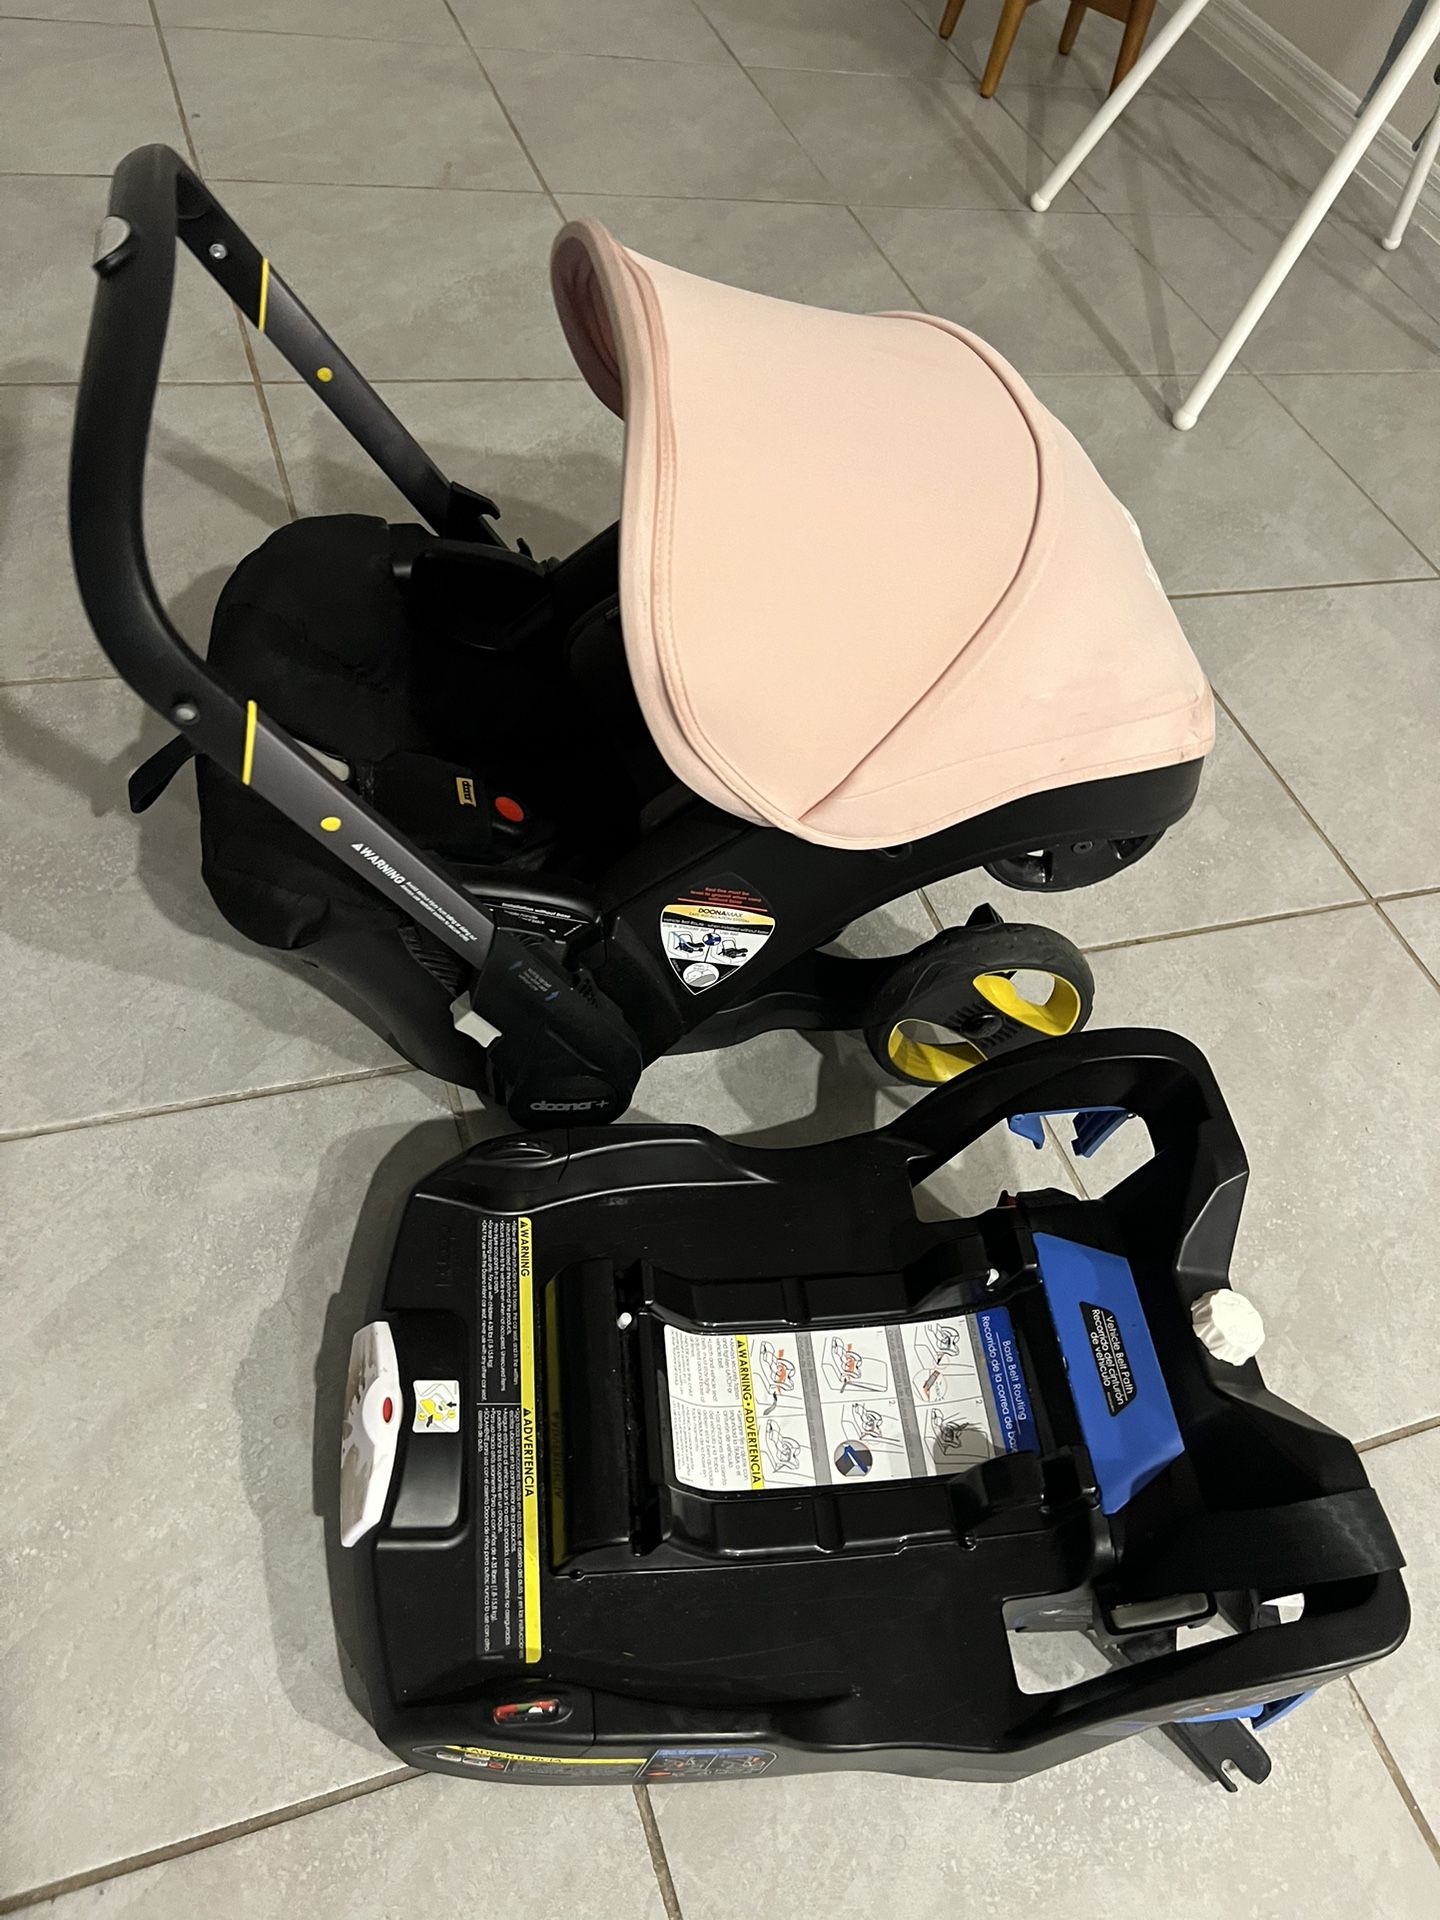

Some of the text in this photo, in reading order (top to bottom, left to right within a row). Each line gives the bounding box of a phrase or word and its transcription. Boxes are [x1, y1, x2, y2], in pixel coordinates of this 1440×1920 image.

[360, 847, 406, 884] WARNING
[520, 1230, 530, 1278] WARNING
[982, 1316, 997, 1358] Recorrido
[1090, 1331, 1101, 1345] de
[1092, 1309, 1110, 1351] Recorrido
[991, 1359, 1001, 1372] de
[1104, 1352, 1116, 1368] del
[1106, 1315, 1134, 1395] Vehicle Belt Path
[994, 1373, 1003, 1383] la
[1003, 1340, 1027, 1421] Base Belt Routing
[1109, 1368, 1125, 1405] cinturón
[738, 1349, 761, 1484] WARNING ADVERTENCIA
[997, 1384, 1010, 1415] correa
[1004, 1416, 1013, 1430] de
[524, 1418, 534, 1497] ADVERTENCIA
[471, 1748, 562, 1762] ADVERTENCIA
